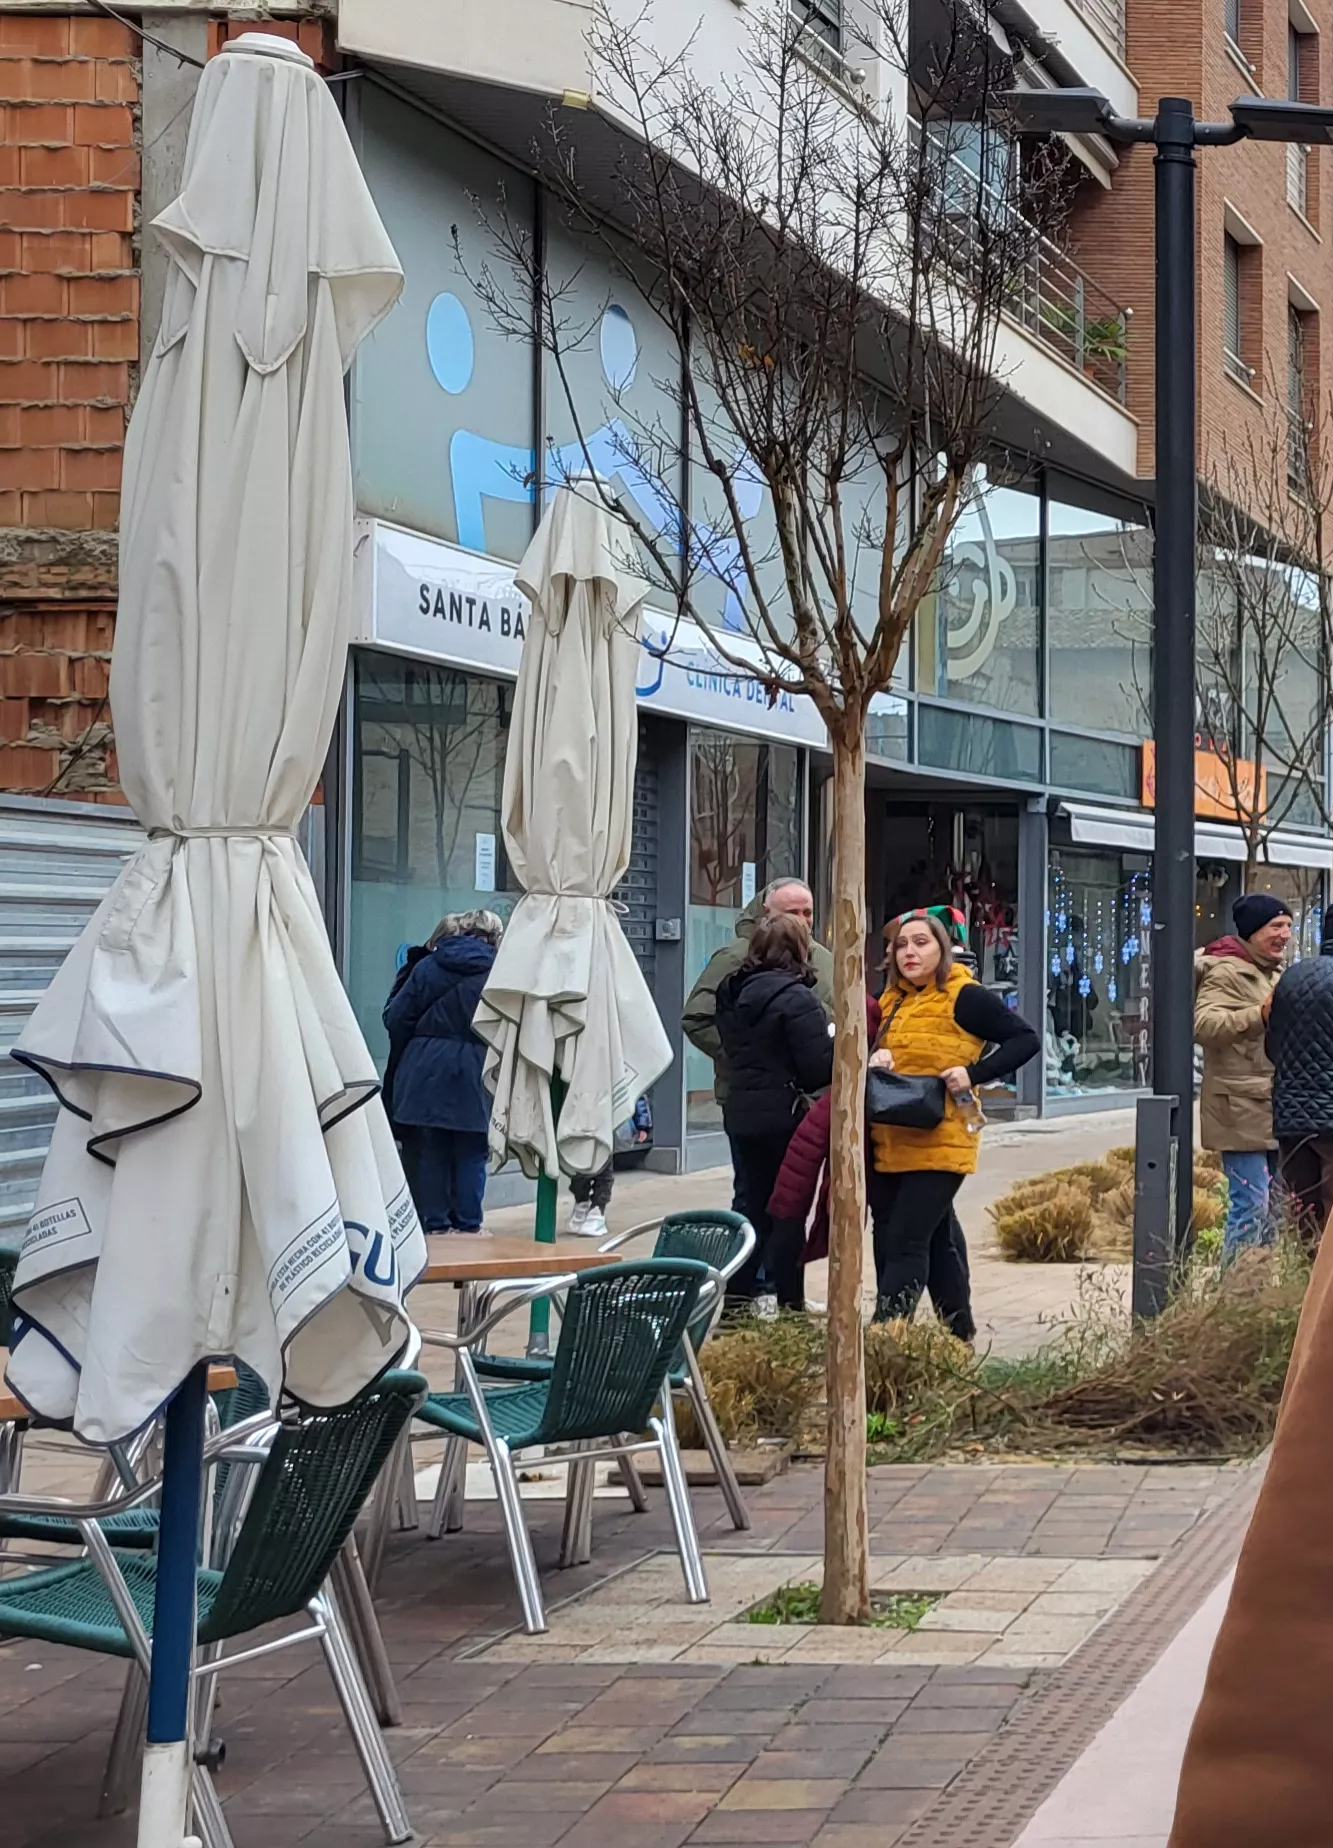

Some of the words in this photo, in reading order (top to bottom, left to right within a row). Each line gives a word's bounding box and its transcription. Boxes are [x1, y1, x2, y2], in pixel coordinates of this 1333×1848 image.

[419, 583, 491, 632] SANTA
[500, 602, 532, 642] BÁ
[746, 679, 795, 713] DEAL
[40, 1208, 77, 1229] BOTELLAS
[287, 1245, 309, 1267] HECHA
[306, 1232, 323, 1248] CON
[279, 1281, 288, 1292] DE
[284, 1254, 314, 1284] PLÁSTICO
